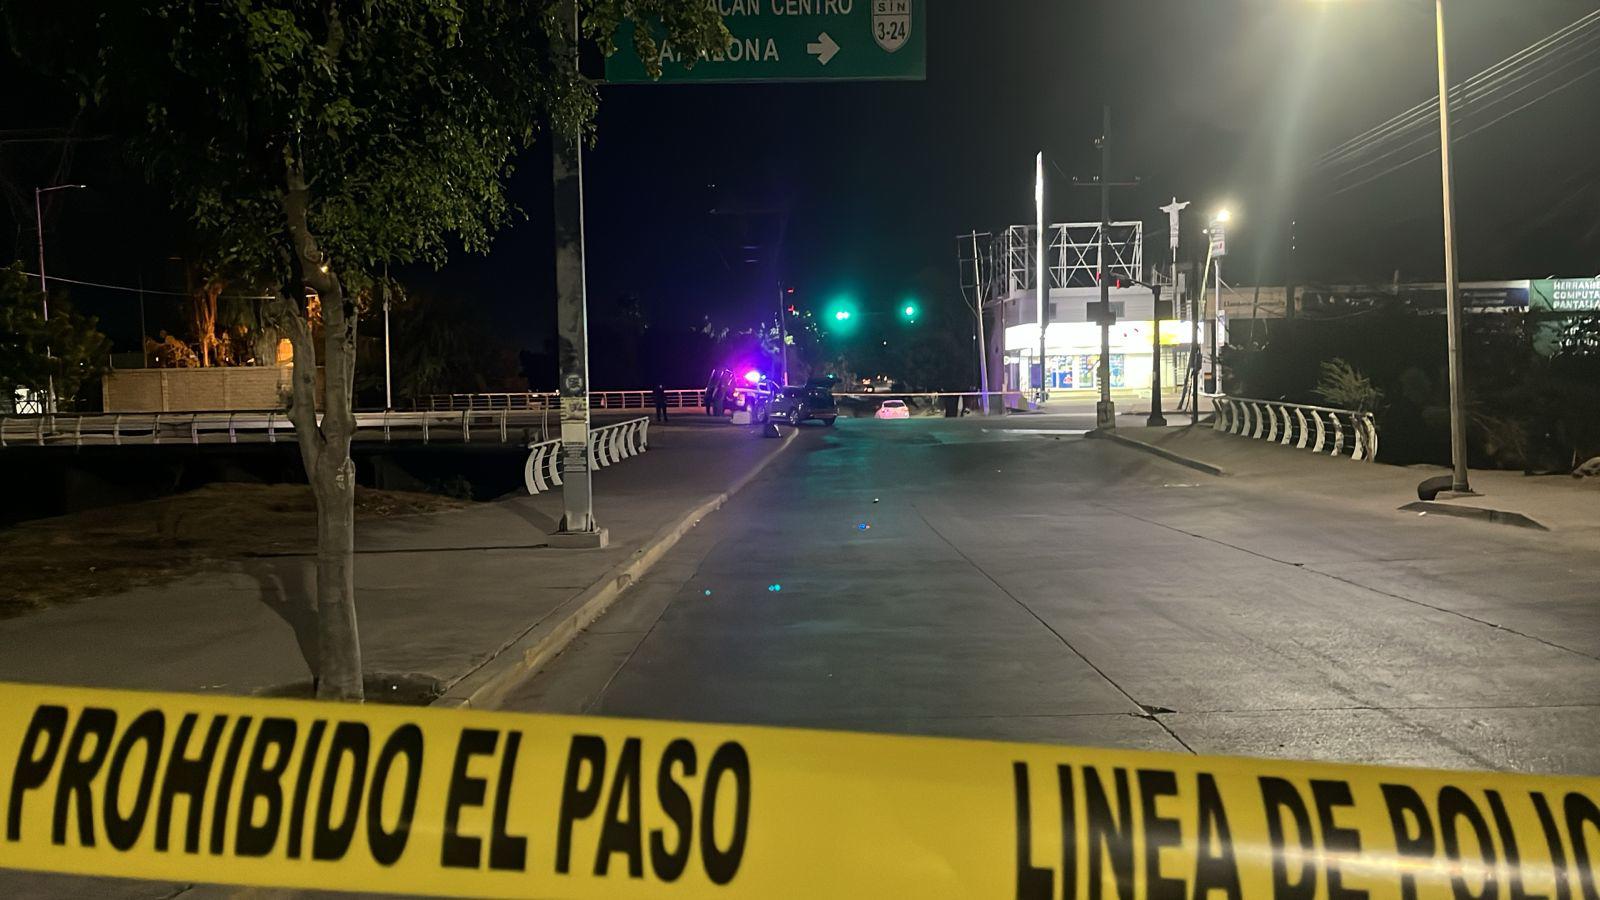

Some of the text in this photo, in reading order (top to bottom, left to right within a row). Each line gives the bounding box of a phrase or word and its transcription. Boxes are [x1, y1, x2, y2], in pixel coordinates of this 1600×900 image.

[878, 2, 905, 12] SIN
[878, 21, 906, 40] 3-24
[6, 704, 751, 886] PROHIBIDO EL PASO
[1012, 760, 1244, 900] LINEA
[1257, 775, 1371, 900] DE
